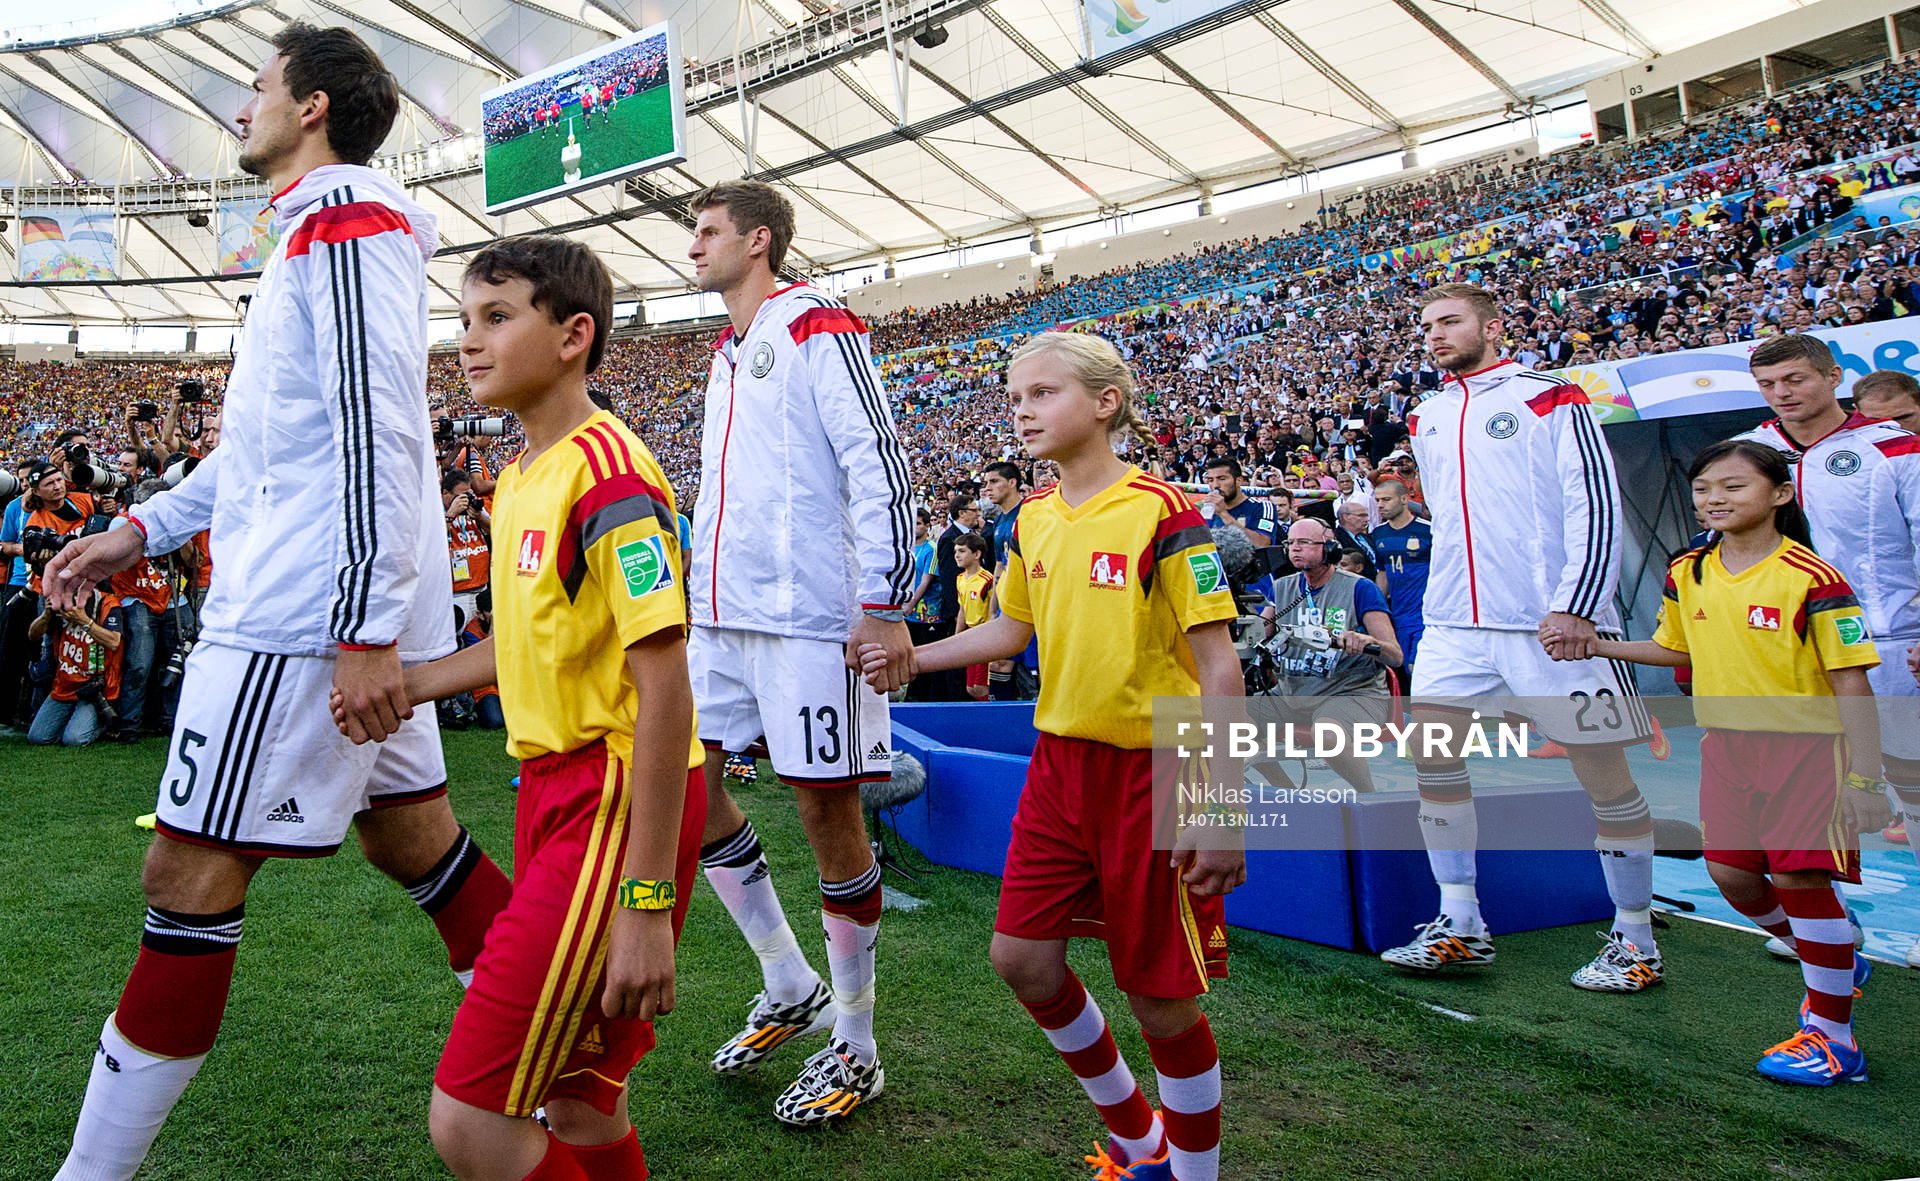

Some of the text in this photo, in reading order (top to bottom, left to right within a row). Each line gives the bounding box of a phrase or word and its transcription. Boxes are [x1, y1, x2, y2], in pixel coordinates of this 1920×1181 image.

[1629, 85, 1643, 96] 03
[1389, 555, 1404, 574] 14
[63, 641, 83, 662] 198
[1570, 688, 1622, 732] 23
[798, 706, 841, 764] 13
[170, 728, 208, 806] 5
[266, 812, 304, 824] adidas
[1418, 814, 1449, 827] FB
[1597, 849, 1627, 858] FB
